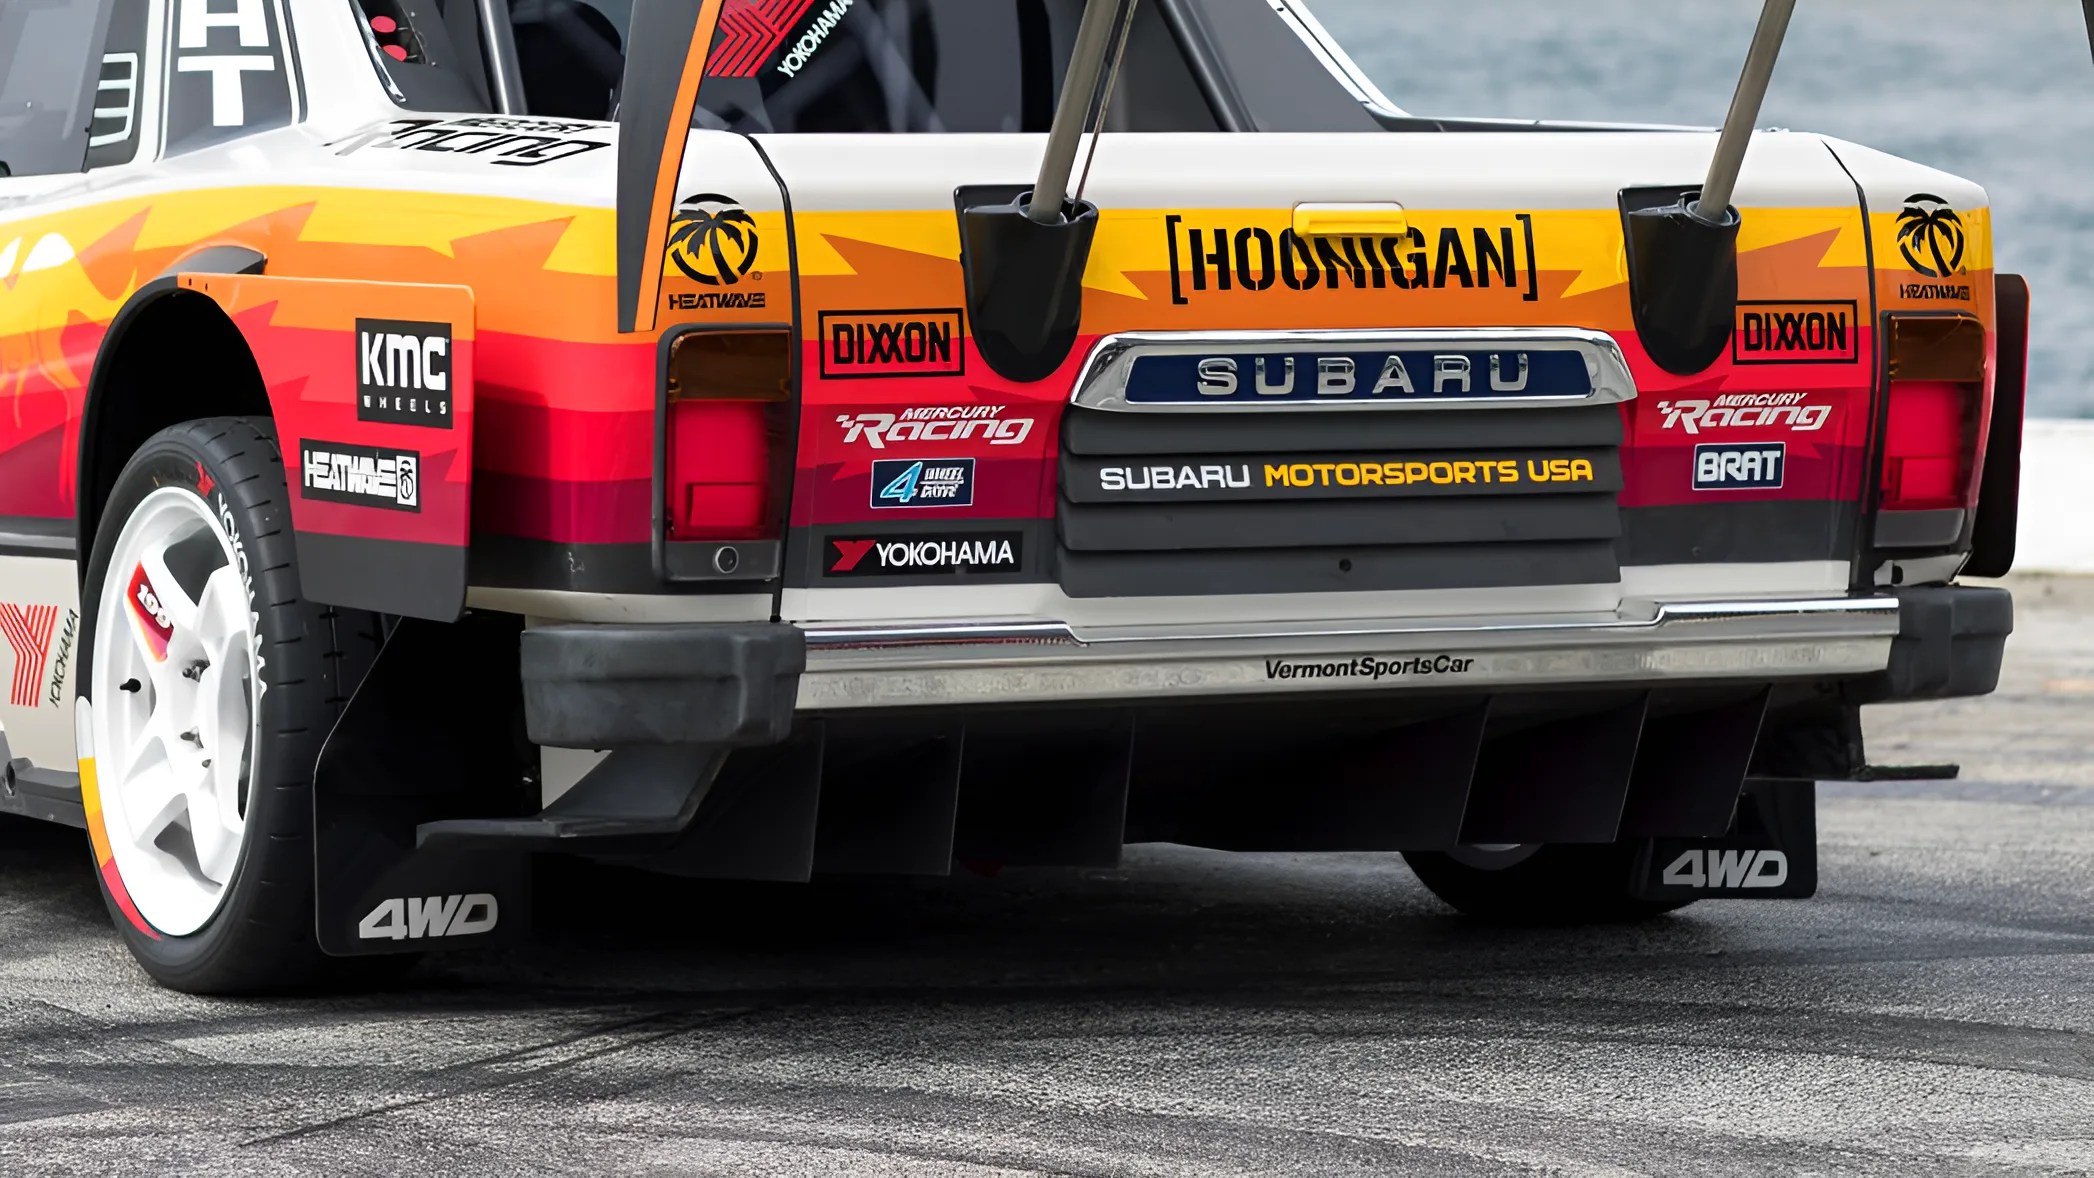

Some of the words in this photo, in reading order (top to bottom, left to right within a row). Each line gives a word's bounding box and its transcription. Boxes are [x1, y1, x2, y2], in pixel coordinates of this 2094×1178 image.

[668, 292, 766, 310] HEATWAVE
[832, 321, 951, 365] DIXXON
[1743, 312, 1846, 351] DIXXON
[1197, 352, 1529, 396] SUBARU
[363, 395, 447, 415] WHEELS
[1657, 399, 1833, 435] Racing
[836, 413, 1035, 449] Racing
[303, 449, 397, 499] HEATWAVE
[1100, 464, 1250, 490] SUBARU
[1264, 460, 1519, 487] MOTORSPORTS
[1527, 459, 1594, 482] USA
[1697, 450, 1781, 483] BRAT
[876, 539, 1014, 567] YOKOHAMA
[1265, 655, 1474, 681] VermontSportsCar
[1662, 849, 1788, 888] 4WD
[358, 893, 498, 940] 4WD
